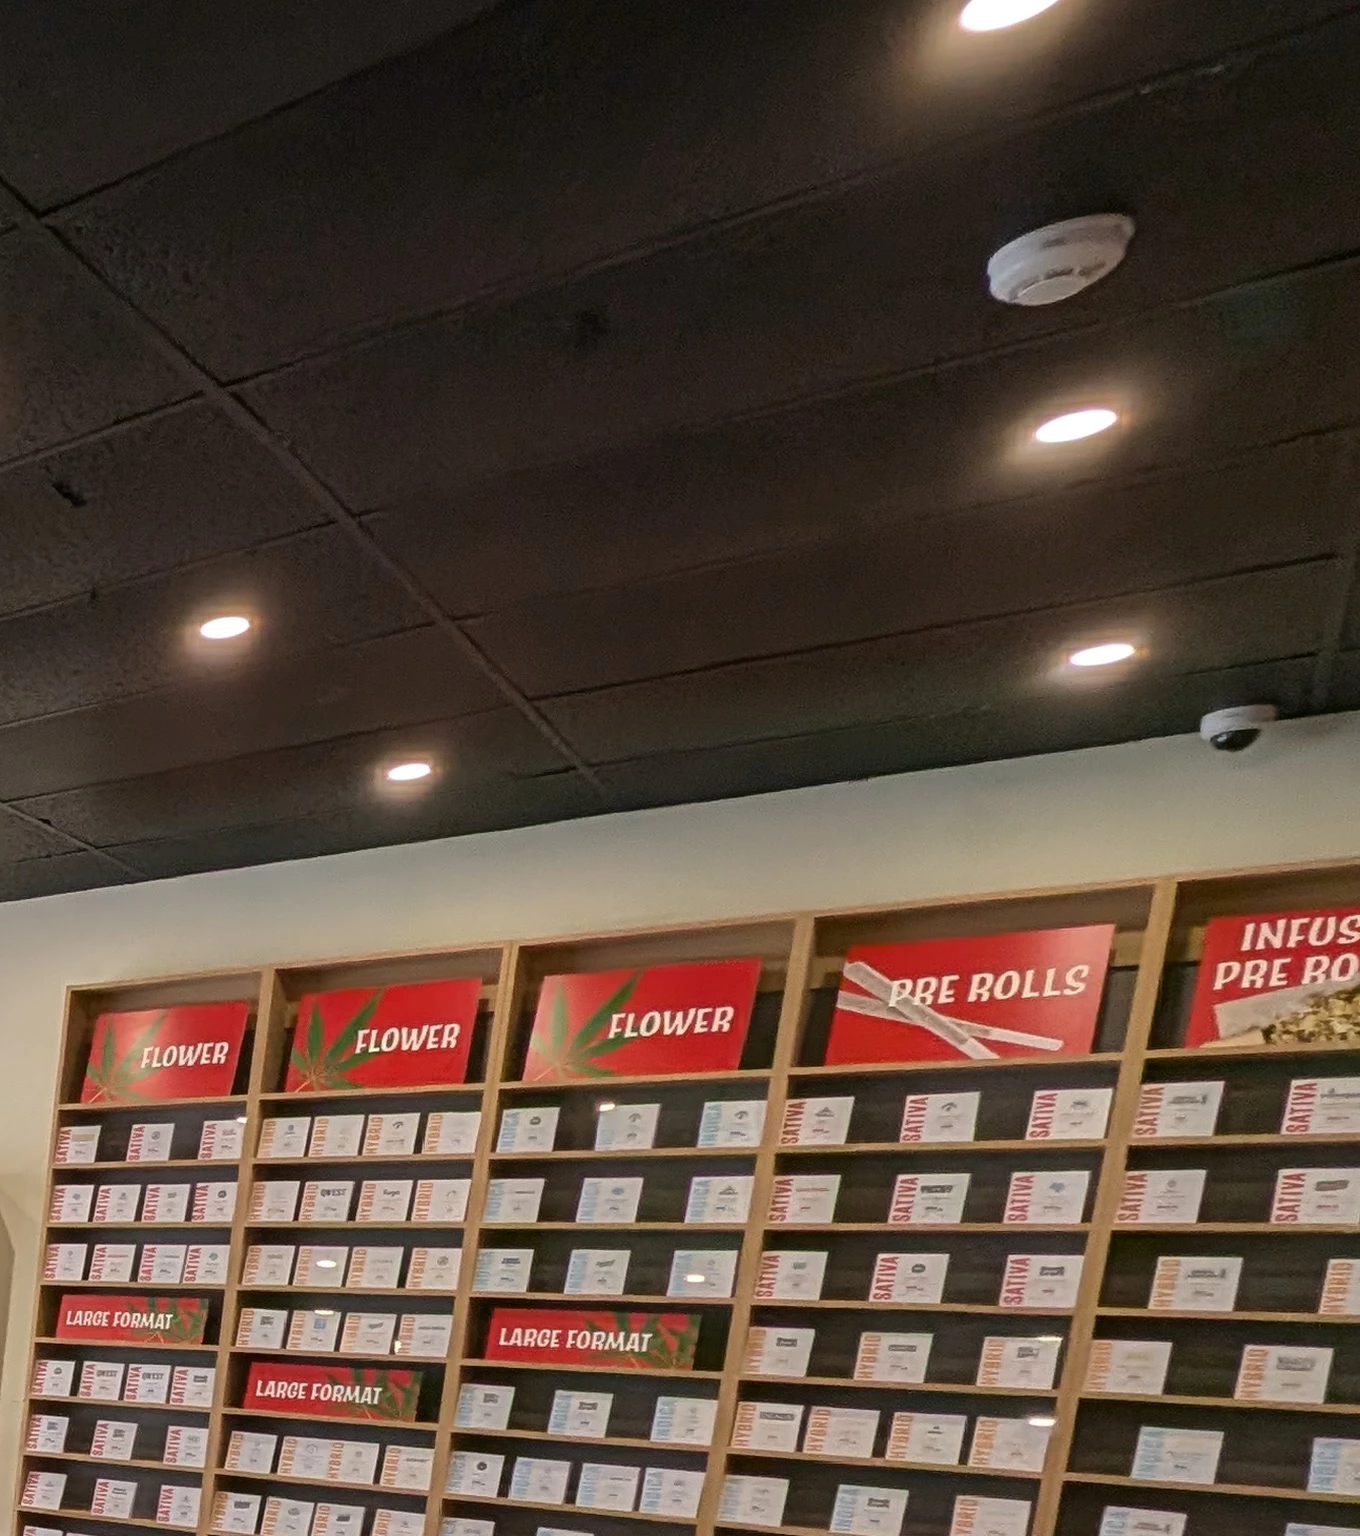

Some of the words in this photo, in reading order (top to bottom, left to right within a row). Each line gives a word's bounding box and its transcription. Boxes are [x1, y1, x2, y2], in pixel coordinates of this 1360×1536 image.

[890, 976, 959, 1006] PRE
[968, 965, 1090, 1001] ROLLS
[1213, 958, 1292, 990] PRE
[354, 1022, 460, 1054] FLOWER
[608, 1006, 735, 1039] FLOWER
[140, 1041, 229, 1068] FLOWER
[781, 1101, 806, 1144] SATIVA
[903, 1097, 929, 1142] SATIVA
[1030, 1092, 1058, 1138] SATIVA
[1135, 1085, 1164, 1135] SATIVA
[1286, 1082, 1318, 1133] SATIVA
[56, 1129, 72, 1162] SATIVA
[129, 1126, 145, 1161] SATIVA
[200, 1123, 217, 1159] SATIVA
[50, 1188, 66, 1221] SATIVA
[95, 1188, 111, 1221] SATIVA
[144, 1187, 160, 1220] SATIVA
[193, 1185, 209, 1220] SATIVA
[769, 1179, 794, 1221] SATIVA
[892, 1178, 919, 1222] SATIVA
[1009, 1176, 1034, 1221] SATIVA
[1118, 1173, 1148, 1221] SATIVA
[1276, 1173, 1306, 1221] SATIVA
[44, 1246, 60, 1279] SATIVA
[91, 1247, 107, 1279] SATIVA
[140, 1247, 156, 1281] SATIVA
[185, 1248, 202, 1282] SATIVA
[756, 1255, 781, 1298] SATIVA
[874, 1256, 899, 1300] SATIVA
[1004, 1258, 1031, 1305] SATIVA
[66, 1311, 110, 1326] LARGE
[113, 1311, 173, 1330] FORMAT
[499, 1328, 566, 1348] LARGE
[566, 1330, 652, 1352] FORMAT
[33, 1360, 47, 1393] SATIVA
[81, 1364, 96, 1397] SATIVA
[126, 1366, 142, 1400] SATIVA
[172, 1369, 188, 1403] SATIVA
[256, 1380, 306, 1399] LARGE
[311, 1383, 382, 1405] FORMAT
[28, 1415, 42, 1449] SATIVA
[93, 1423, 109, 1456] SATIVA
[165, 1429, 182, 1463] SATIVA
[24, 1473, 40, 1504] SATIVA
[93, 1481, 109, 1514] SATIVA
[158, 1488, 174, 1522] SATIVA
